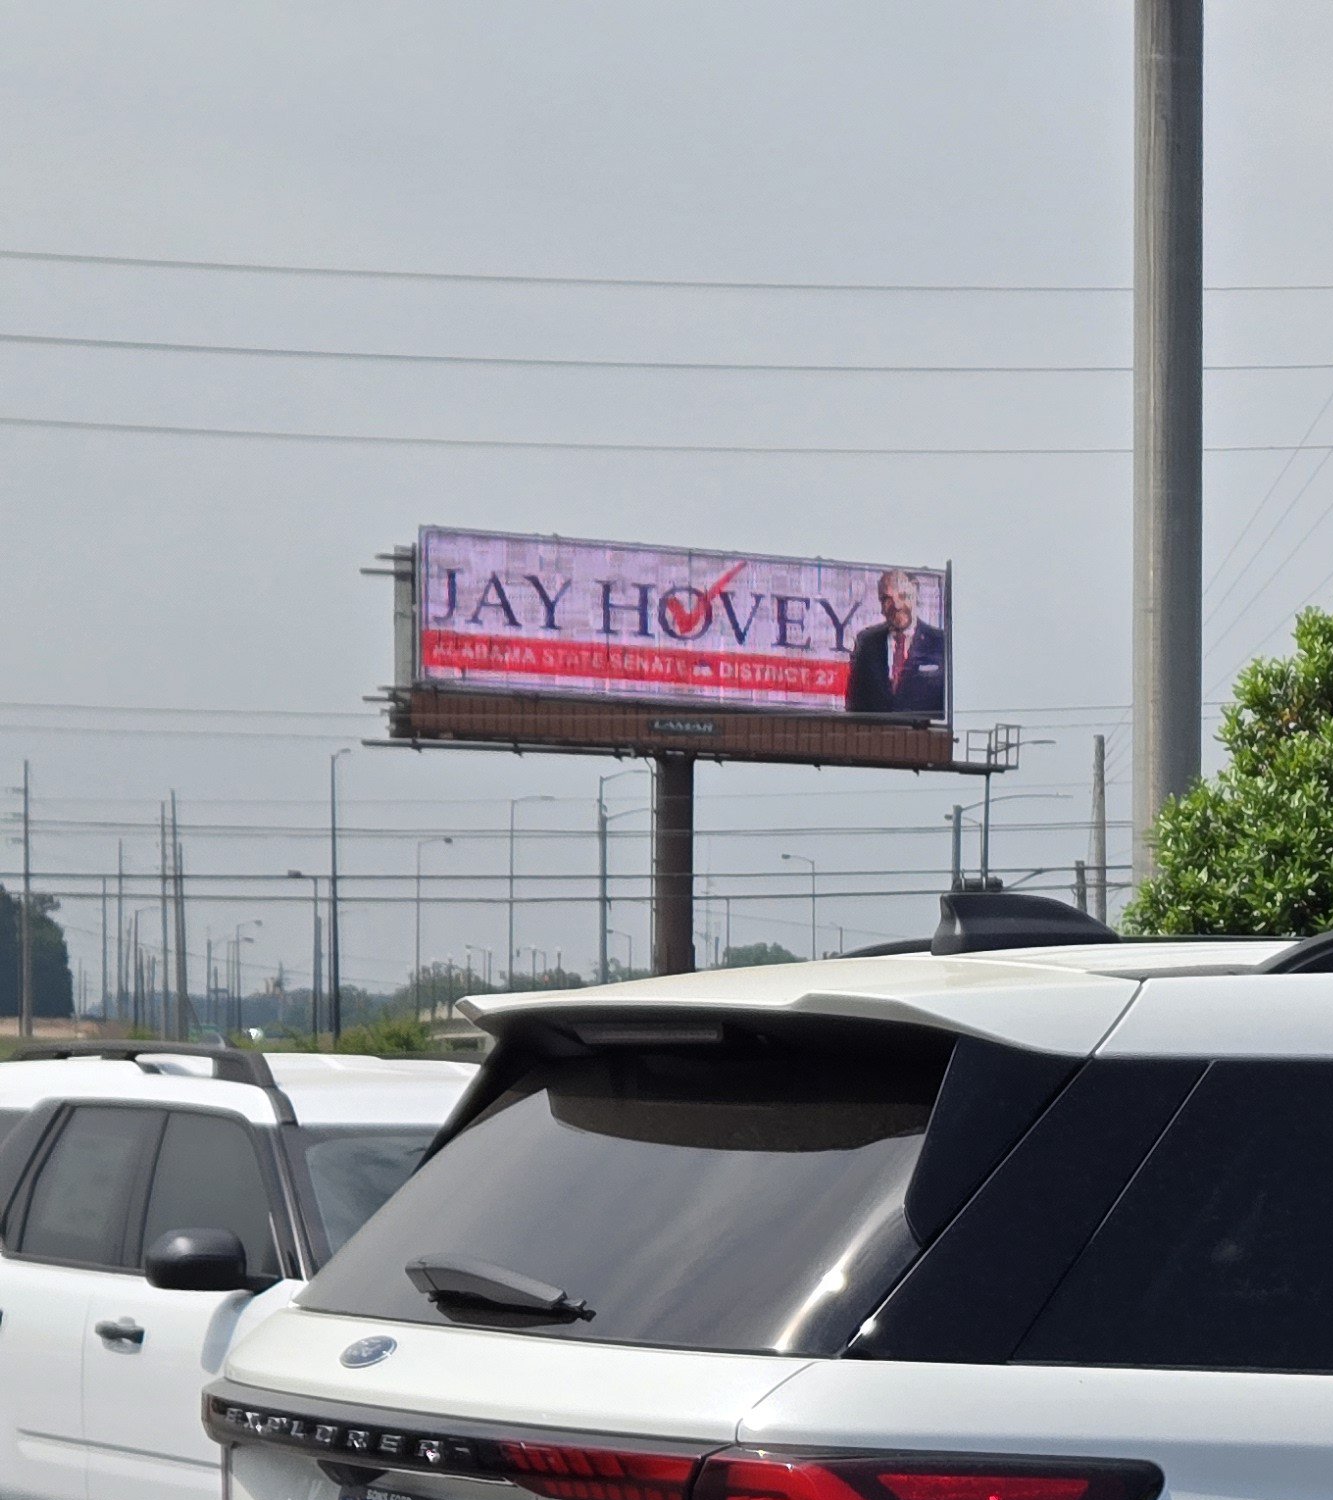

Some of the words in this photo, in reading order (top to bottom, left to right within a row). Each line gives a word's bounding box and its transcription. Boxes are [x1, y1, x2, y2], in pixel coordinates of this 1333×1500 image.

[432, 567, 572, 631] JAY
[595, 579, 862, 652] HOVEY
[432, 642, 536, 665] ALABAMA
[543, 649, 606, 669] STATE
[610, 654, 687, 674] SENATE
[719, 661, 810, 685] DISTRICT
[225, 1407, 445, 1464] EXPLORER
